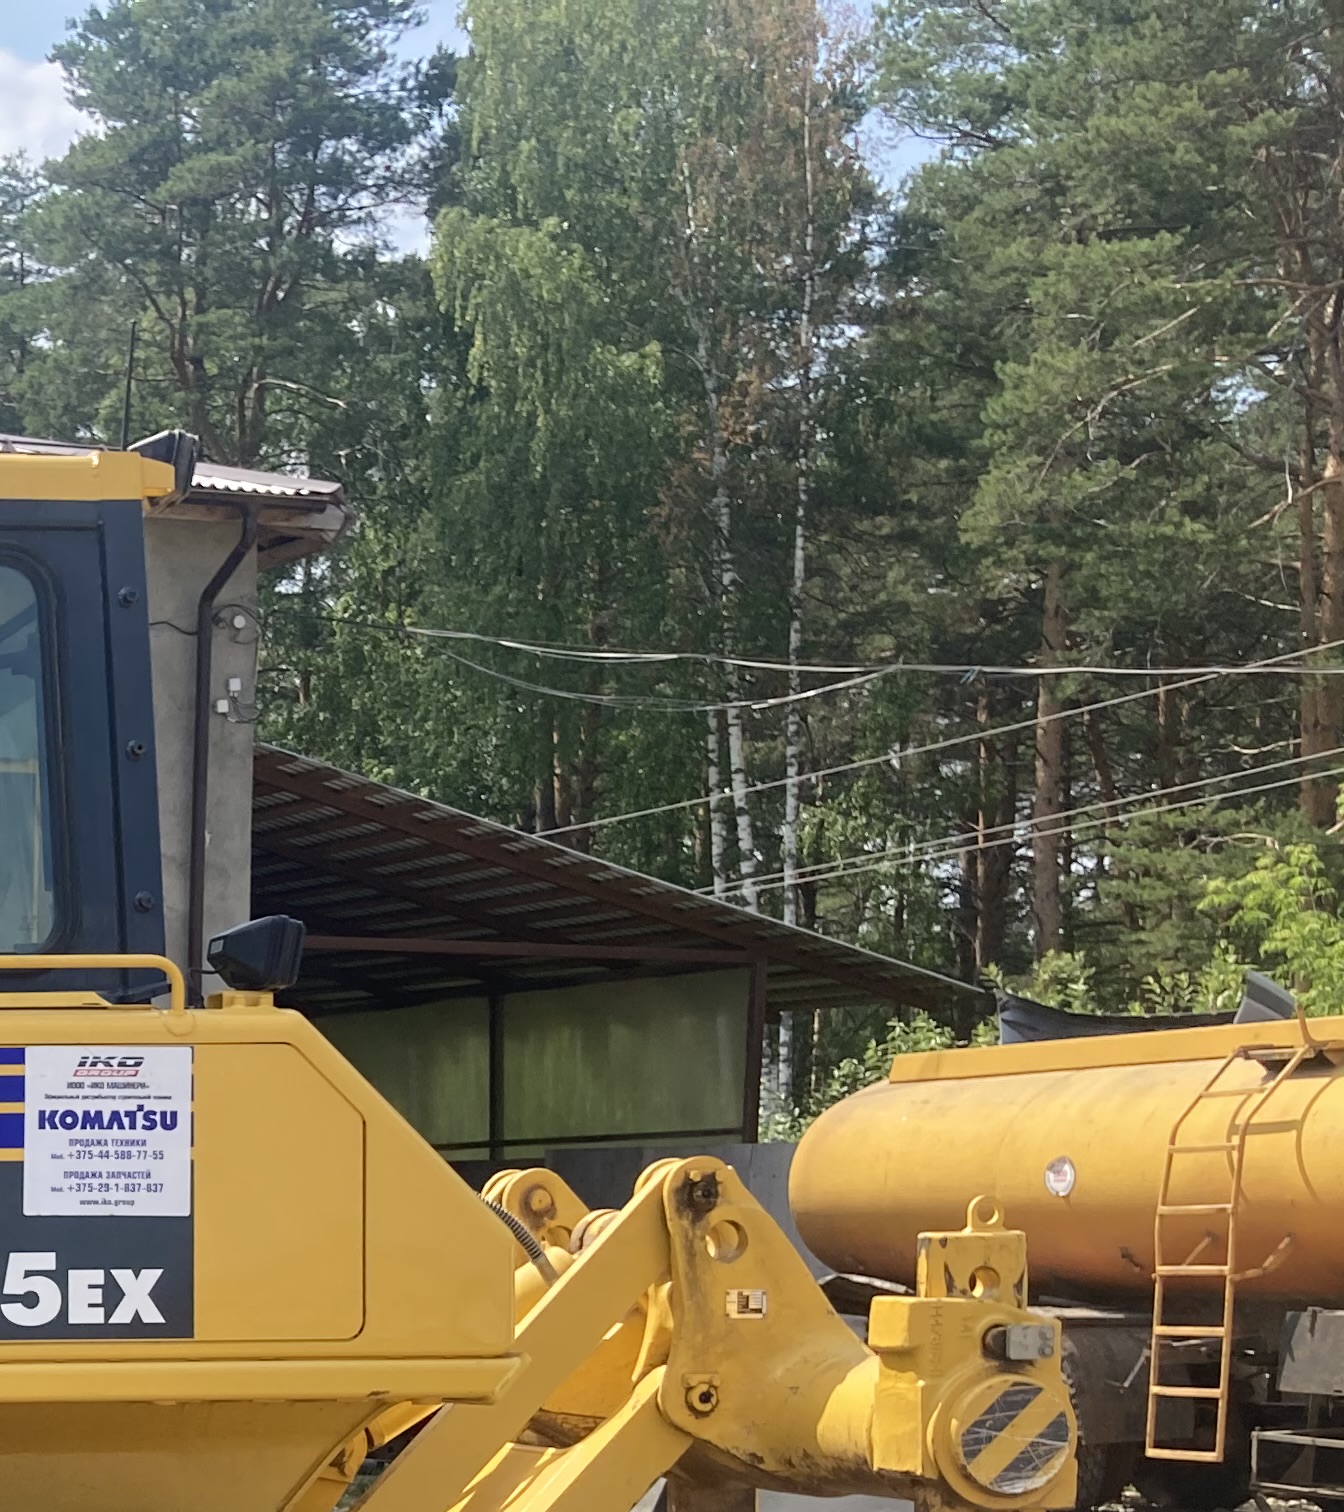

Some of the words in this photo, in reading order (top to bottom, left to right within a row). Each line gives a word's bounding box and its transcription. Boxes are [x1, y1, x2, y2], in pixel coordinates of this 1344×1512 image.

[77, 1056, 144, 1068] IKO
[75, 1069, 137, 1077] GROUP
[38, 1104, 178, 1130] KOMATSU
[69, 1138, 108, 1148] ПРОДАЖА
[111, 1138, 146, 1147] ТЕХНИКИ
[67, 1150, 164, 1160] +375-44-588-77-55
[64, 1170, 103, 1180] ПРОДАЖА
[106, 1169, 151, 1179] ЗАПЧАСТЕЙ
[79, 1198, 135, 1206] www.iko.group
